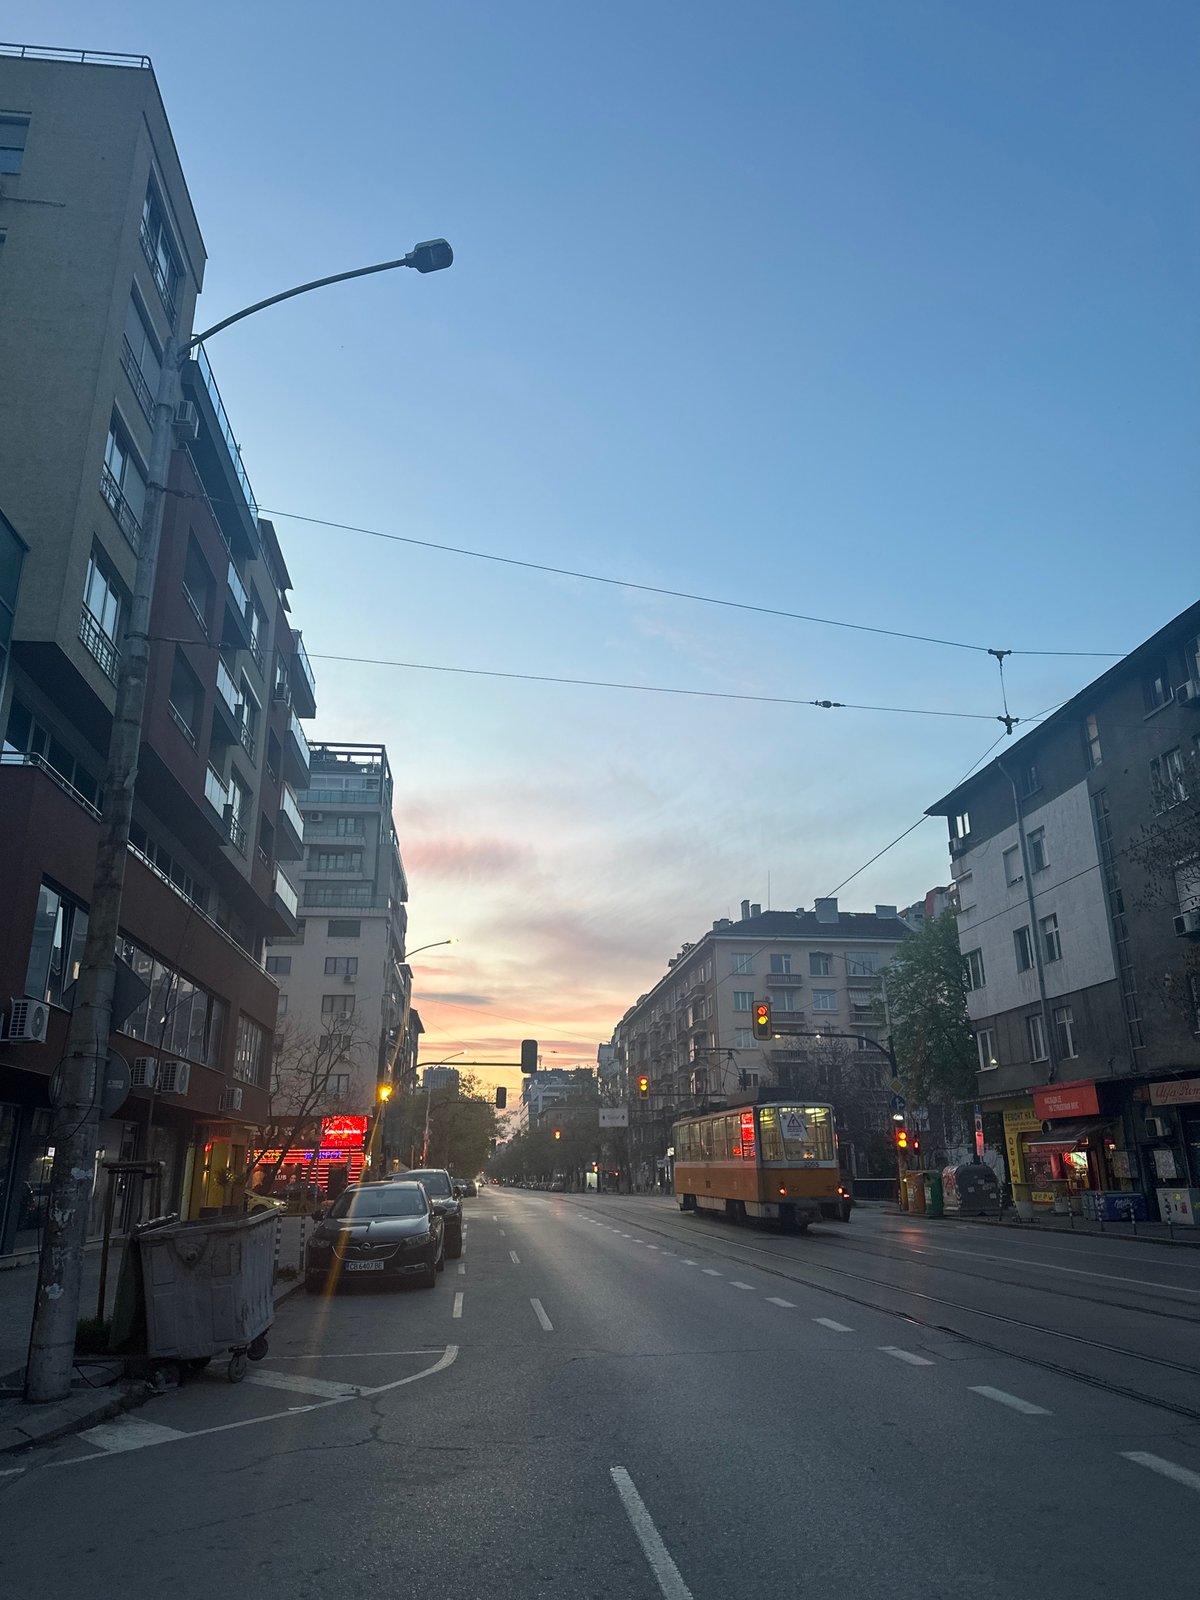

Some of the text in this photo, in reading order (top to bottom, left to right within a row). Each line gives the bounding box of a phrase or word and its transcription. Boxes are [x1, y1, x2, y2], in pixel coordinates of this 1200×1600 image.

[1179, 1081, 1200, 1097] Rom
[253, 1151, 282, 1160] SOTS
[304, 1151, 343, 1160] JAKPOT
[1114, 1197, 1136, 1210] Milk
